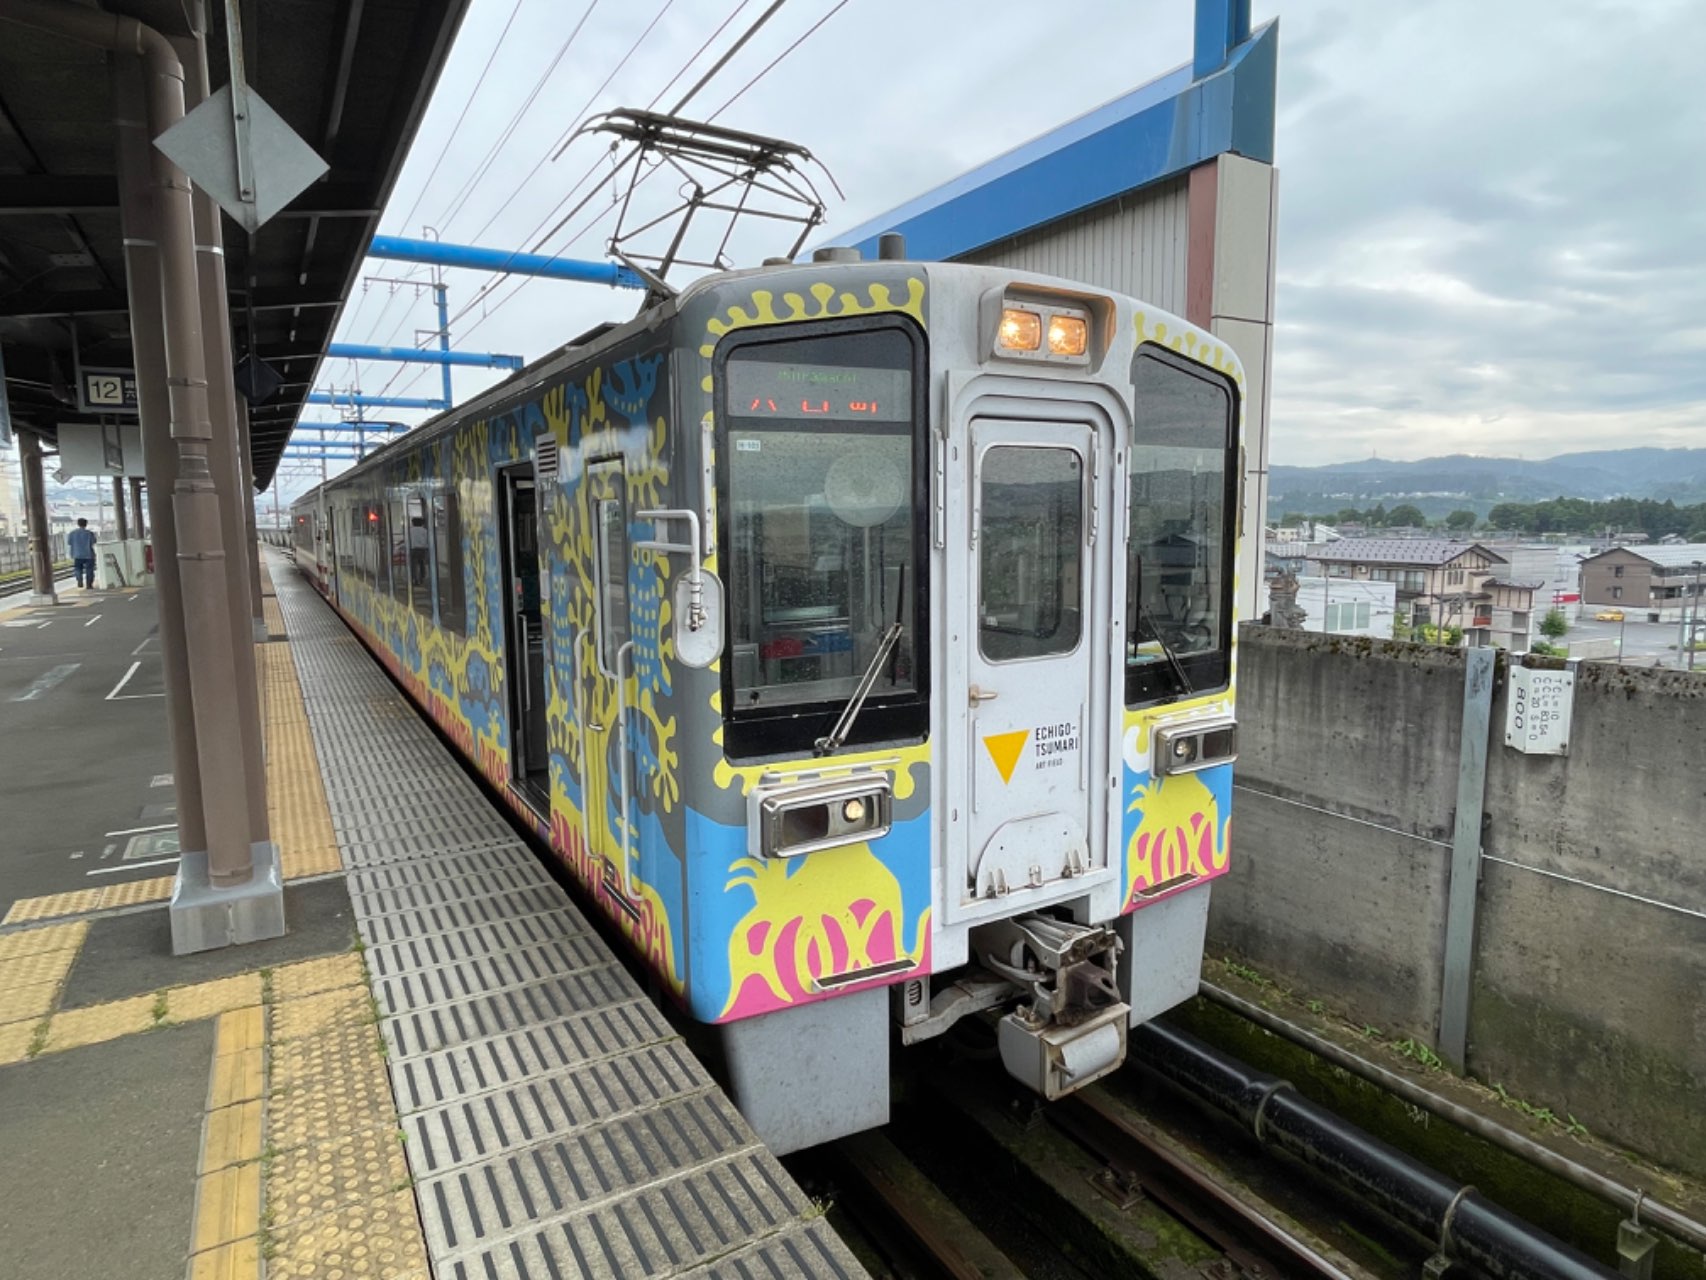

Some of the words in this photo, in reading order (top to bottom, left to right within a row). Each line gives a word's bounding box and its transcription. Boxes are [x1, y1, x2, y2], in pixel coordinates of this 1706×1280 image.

[91, 380, 119, 399] 12
[1515, 687, 1526, 729] 800
[1035, 722, 1077, 741] ECHIGO-
[1035, 737, 1078, 757] TSUMARI
